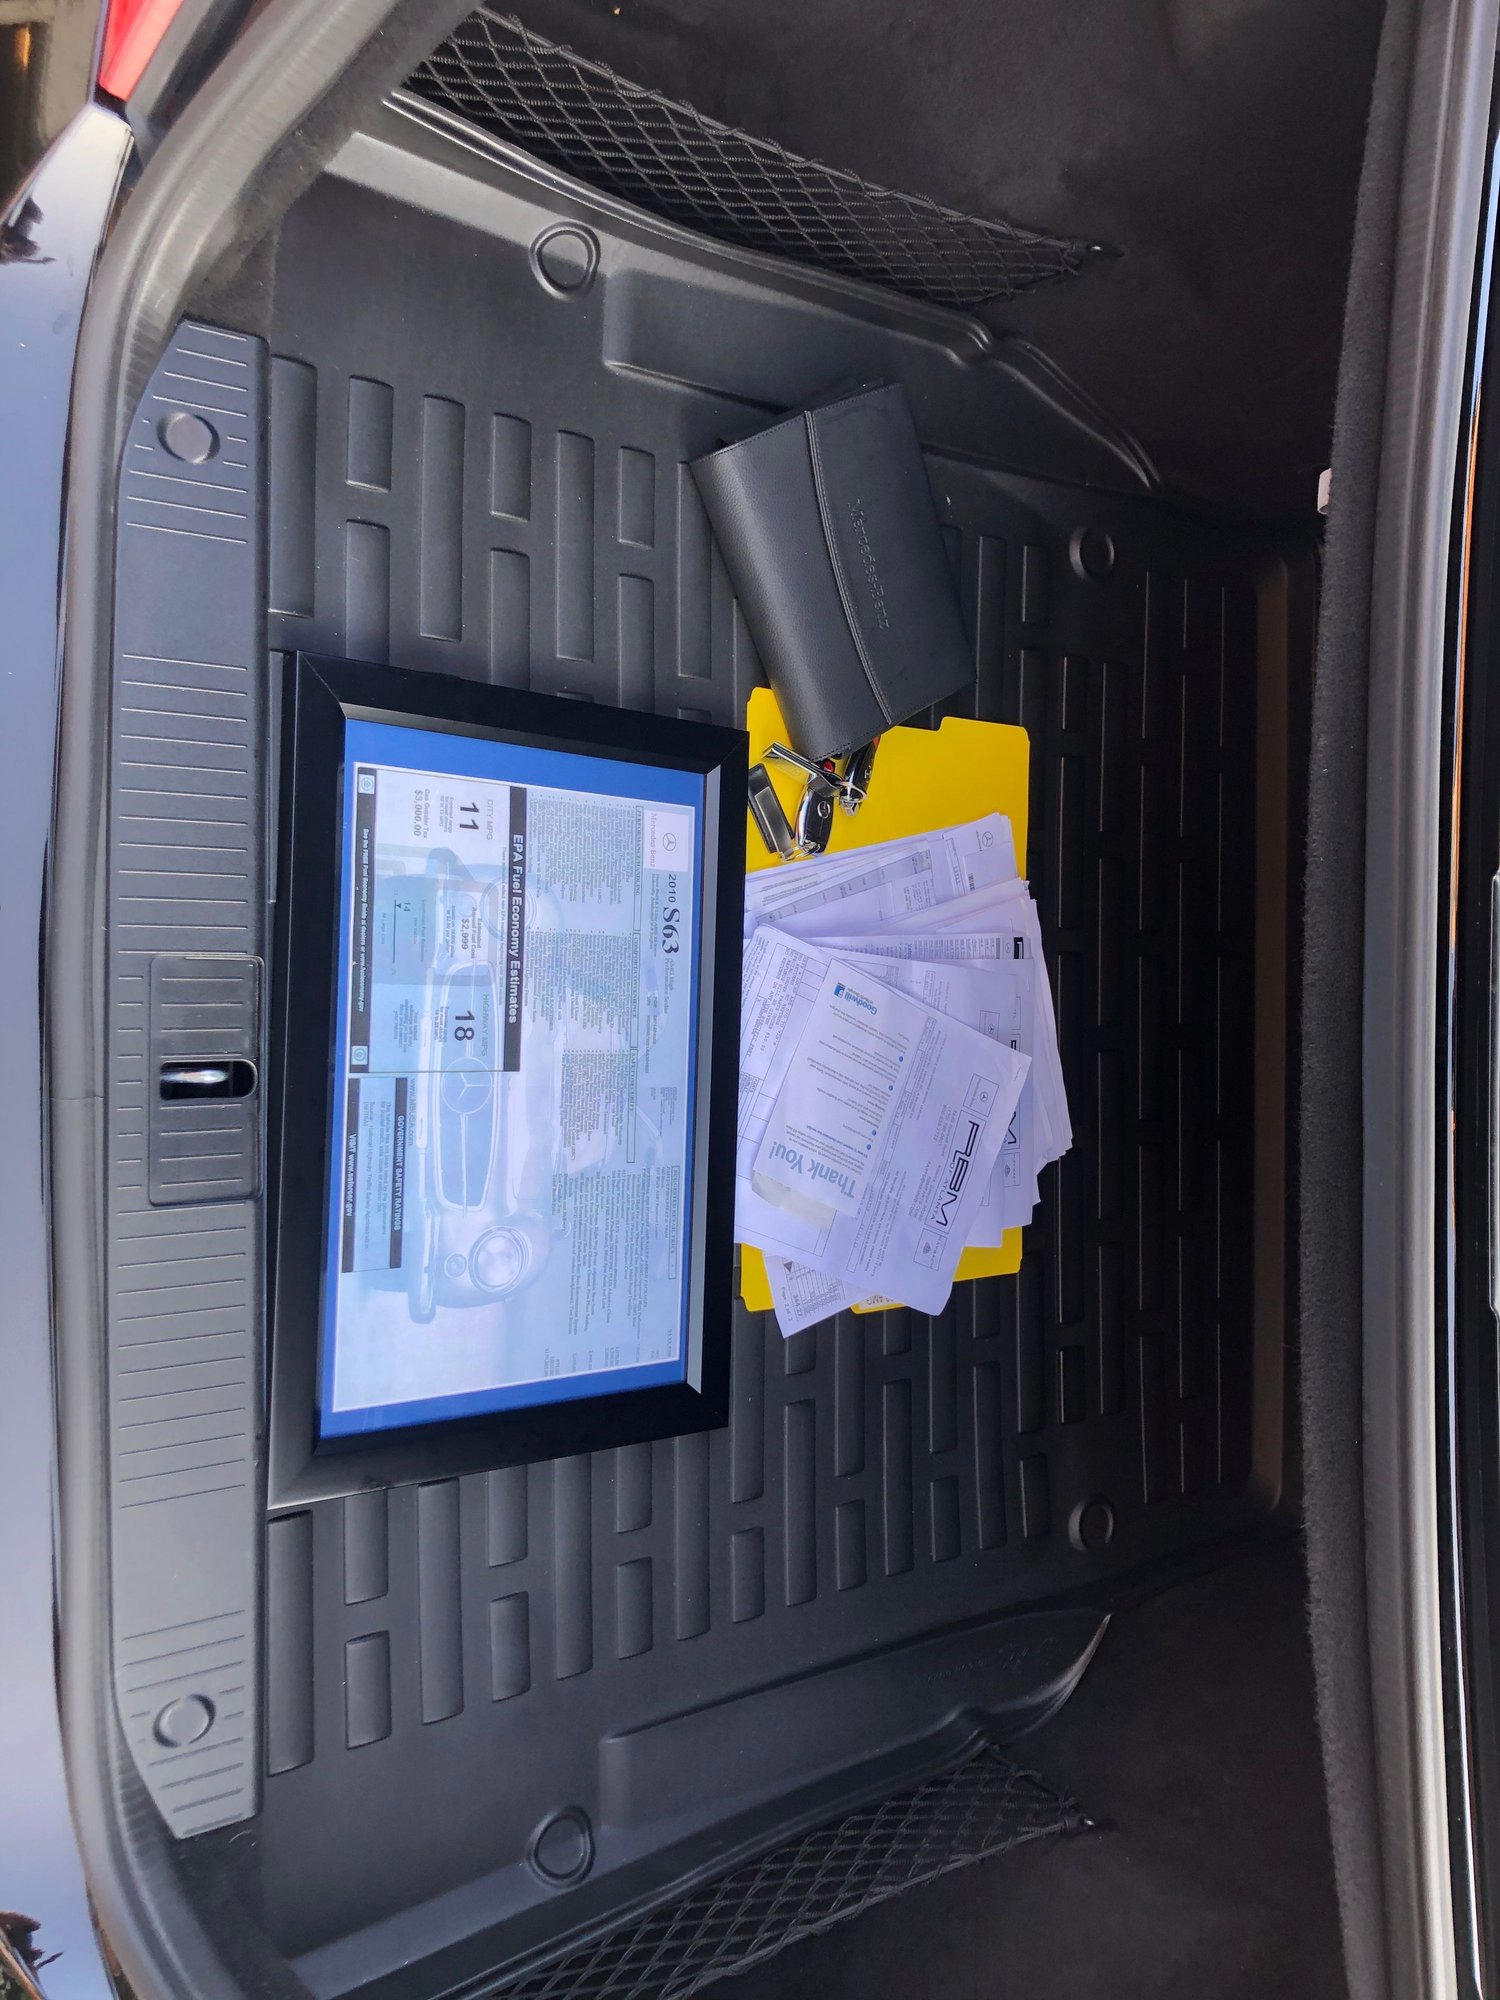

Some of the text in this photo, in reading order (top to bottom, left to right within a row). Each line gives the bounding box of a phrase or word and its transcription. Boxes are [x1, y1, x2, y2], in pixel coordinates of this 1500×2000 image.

[848, 499, 890, 629] Mercedes-Benz
[413, 789, 422, 837] $3,000.00
[459, 802, 480, 830] 11
[649, 813, 658, 868] Mercedes-Benz
[404, 902, 411, 911] 14
[509, 834, 524, 1023] EPA Fuel Economy Estimates
[662, 873, 681, 954] 2010 S63
[461, 918, 469, 950] $2,999
[454, 1010, 475, 1041] 18
[844, 992, 878, 1015] Goodwill
[408, 1078, 416, 1146] www.MBUSA.com
[396, 1115, 404, 1166] GOVERNMENT
[769, 1141, 804, 1174] You!
[345, 1134, 357, 1217] VISIT www.safercar.gov
[807, 1159, 856, 1199] Thank
[936, 1120, 980, 1226] RBM
[931, 1179, 949, 1220] ATLANTA
